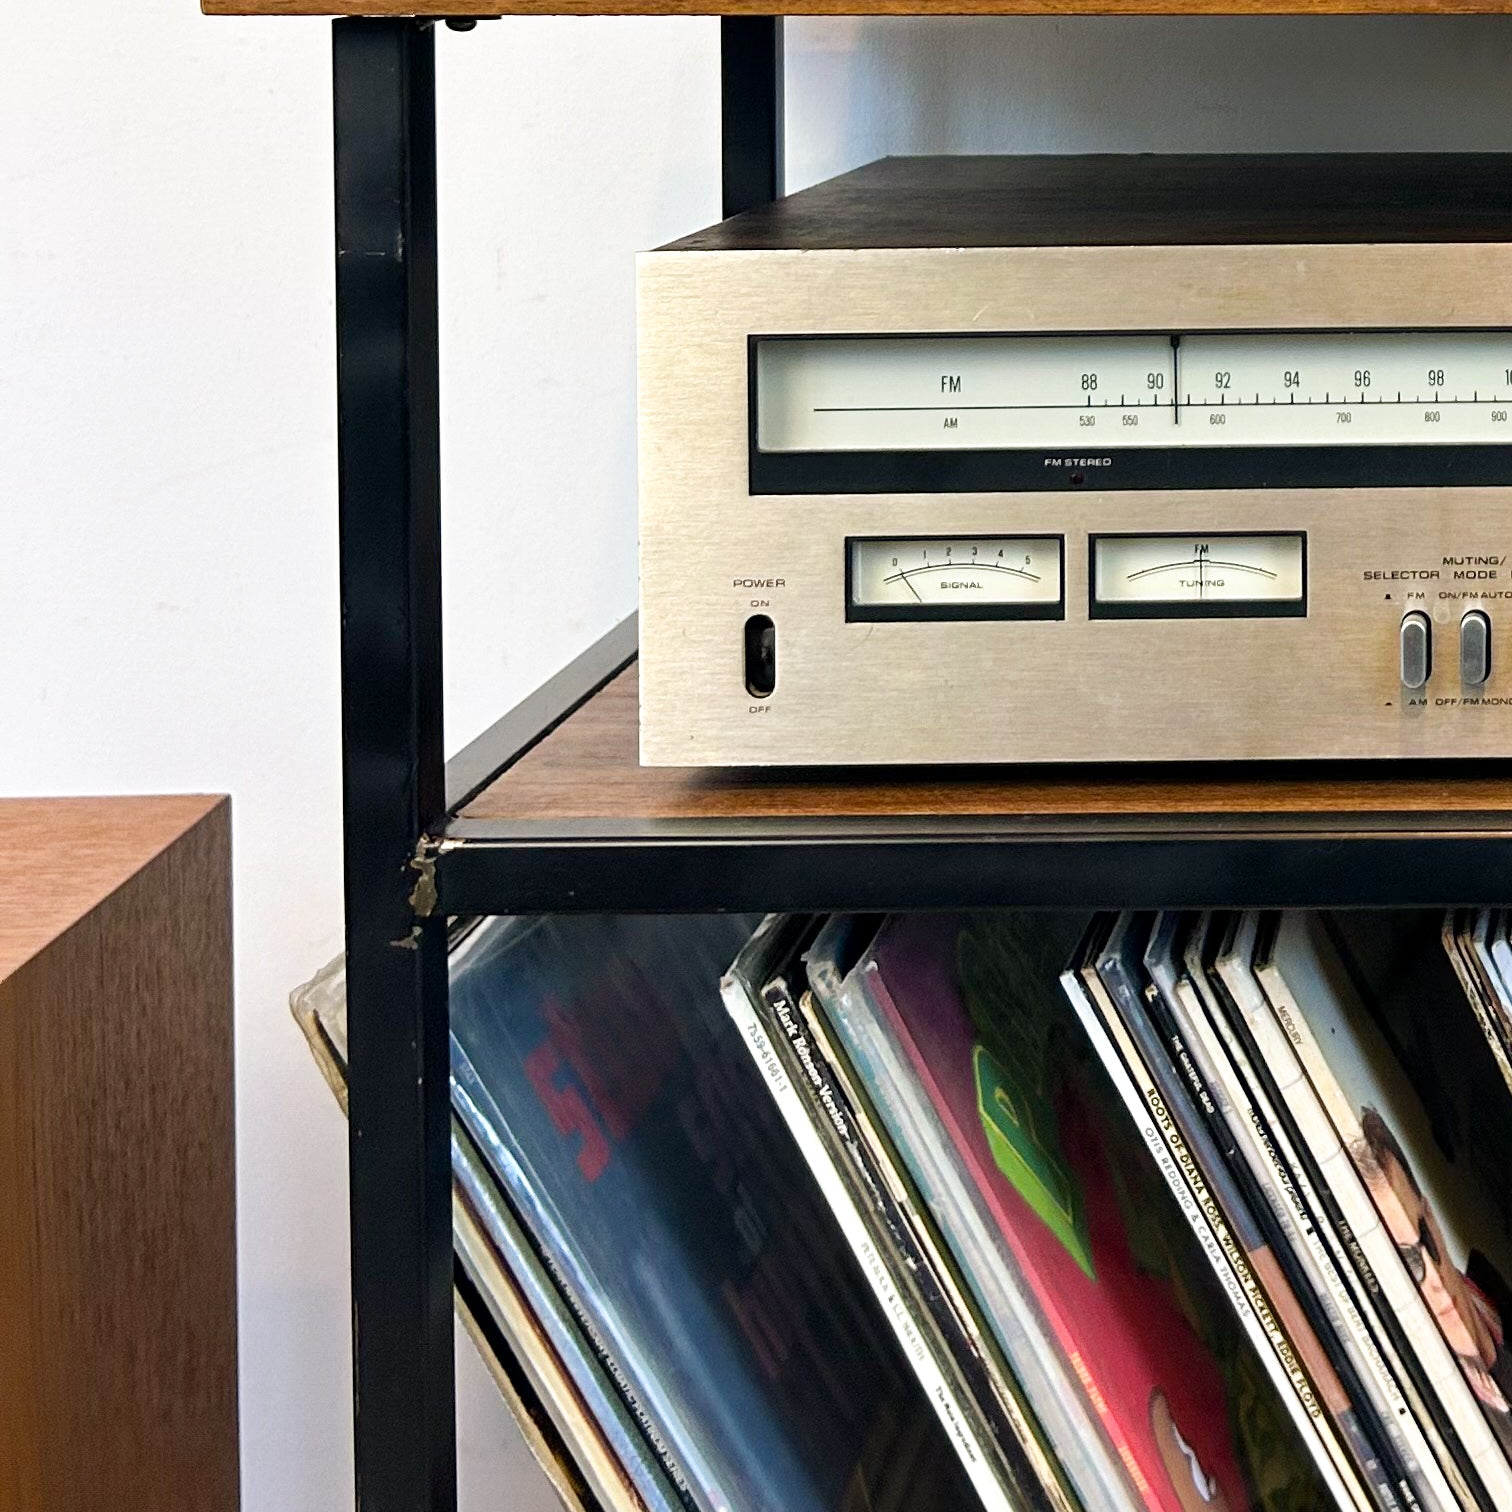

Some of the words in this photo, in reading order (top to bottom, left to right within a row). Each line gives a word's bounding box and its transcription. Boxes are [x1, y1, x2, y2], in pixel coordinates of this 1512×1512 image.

[942, 376, 960, 392] FM
[1082, 374, 1097, 390] 88
[1148, 373, 1163, 389] 90
[1216, 372, 1230, 388] 92
[1284, 371, 1299, 388] 94
[1355, 370, 1370, 387] 96
[1429, 370, 1444, 386] 98
[943, 417, 958, 429] AM
[1079, 415, 1096, 427] 530
[1209, 413, 1226, 426] 600
[1335, 411, 1352, 424] 700
[1491, 410, 1508, 422] 900
[1044, 458, 1062, 467] FM
[1064, 457, 1112, 467] STEREO
[1442, 556, 1507, 567] MUTING/
[1363, 570, 1440, 581] SELECTOR
[1453, 569, 1498, 580] MODE
[732, 578, 786, 589] POWER
[940, 581, 984, 590] SIGNAL
[1178, 579, 1226, 589] TUNING
[1407, 591, 1426, 600] FM
[750, 599, 770, 608] ON
[1408, 697, 1428, 706] AM
[748, 705, 772, 714] OFF
[1276, 1005, 1304, 1047] MERCURY
[772, 997, 801, 1037] Mark
[791, 1035, 826, 1086] Ronson
[816, 1083, 852, 1135] Version
[1170, 1034, 1184, 1052] THE
[1178, 1051, 1204, 1093] GRATEFUL
[1198, 1091, 1215, 1115] DEAD
[1144, 1126, 1163, 1154] OTIS
[1160, 1156, 1193, 1210] REDDING
[1196, 1225, 1222, 1264] CARLA
[1218, 1266, 1251, 1318] THOMAS
[1145, 1088, 1174, 1132] ROOTS
[1168, 1133, 1183, 1150] OF
[1179, 1153, 1206, 1194] DIANA
[1220, 1234, 1252, 1284] WILSON
[1275, 1340, 1300, 1375] EDDIE
[1295, 1377, 1323, 1420] FLOYD
